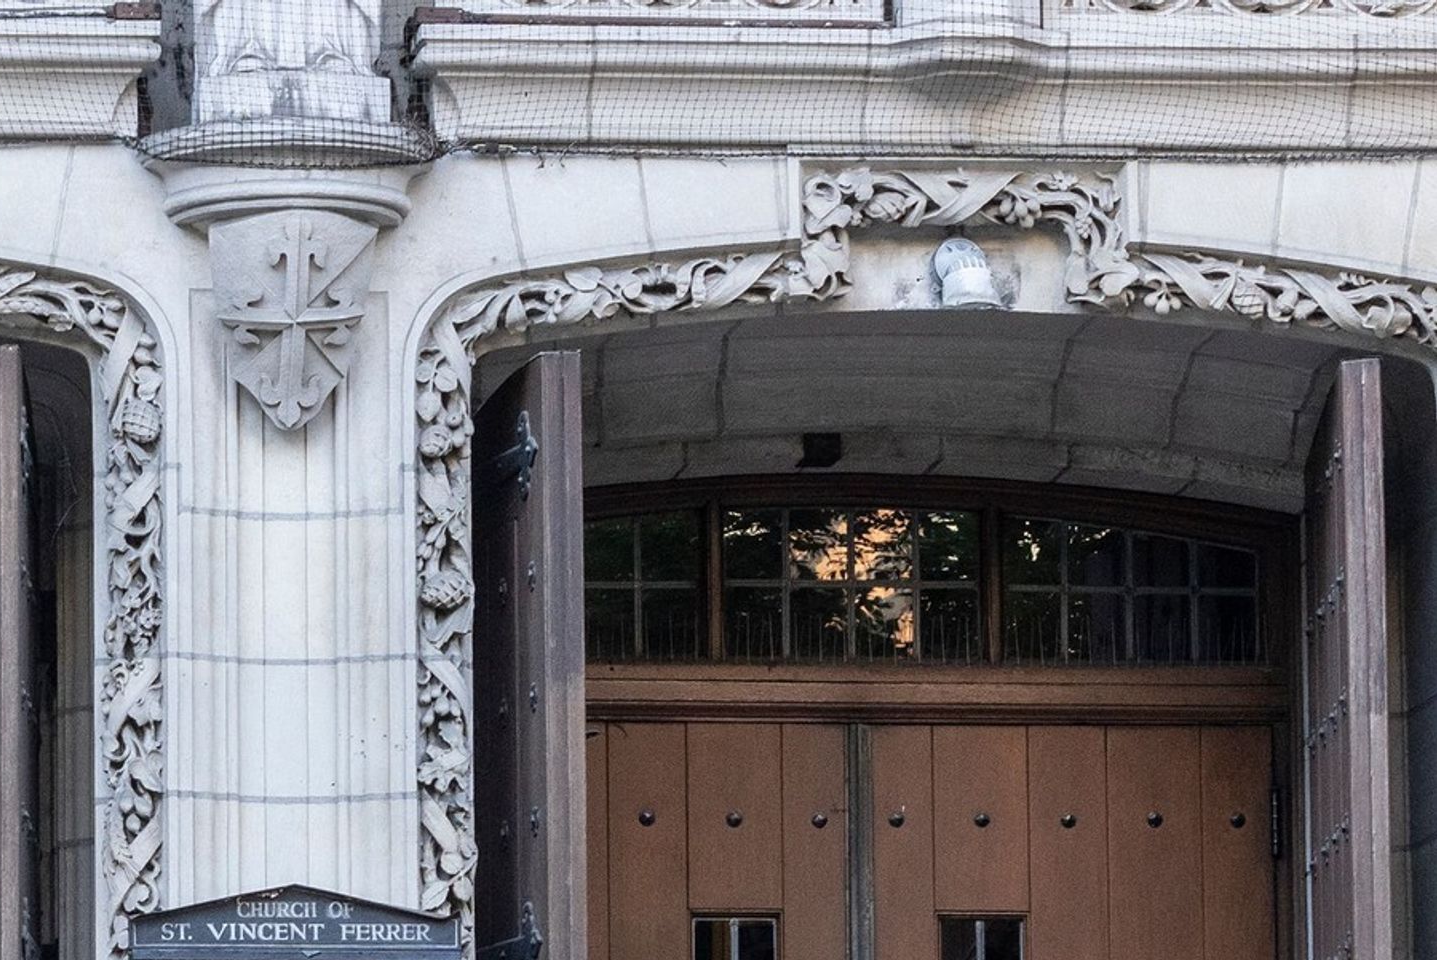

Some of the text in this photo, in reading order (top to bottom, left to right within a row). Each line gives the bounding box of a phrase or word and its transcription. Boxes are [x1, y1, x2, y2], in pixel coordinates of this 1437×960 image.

[237, 901, 354, 918] CHURCH OF
[161, 923, 431, 941] ST. VINCENT FERRER
